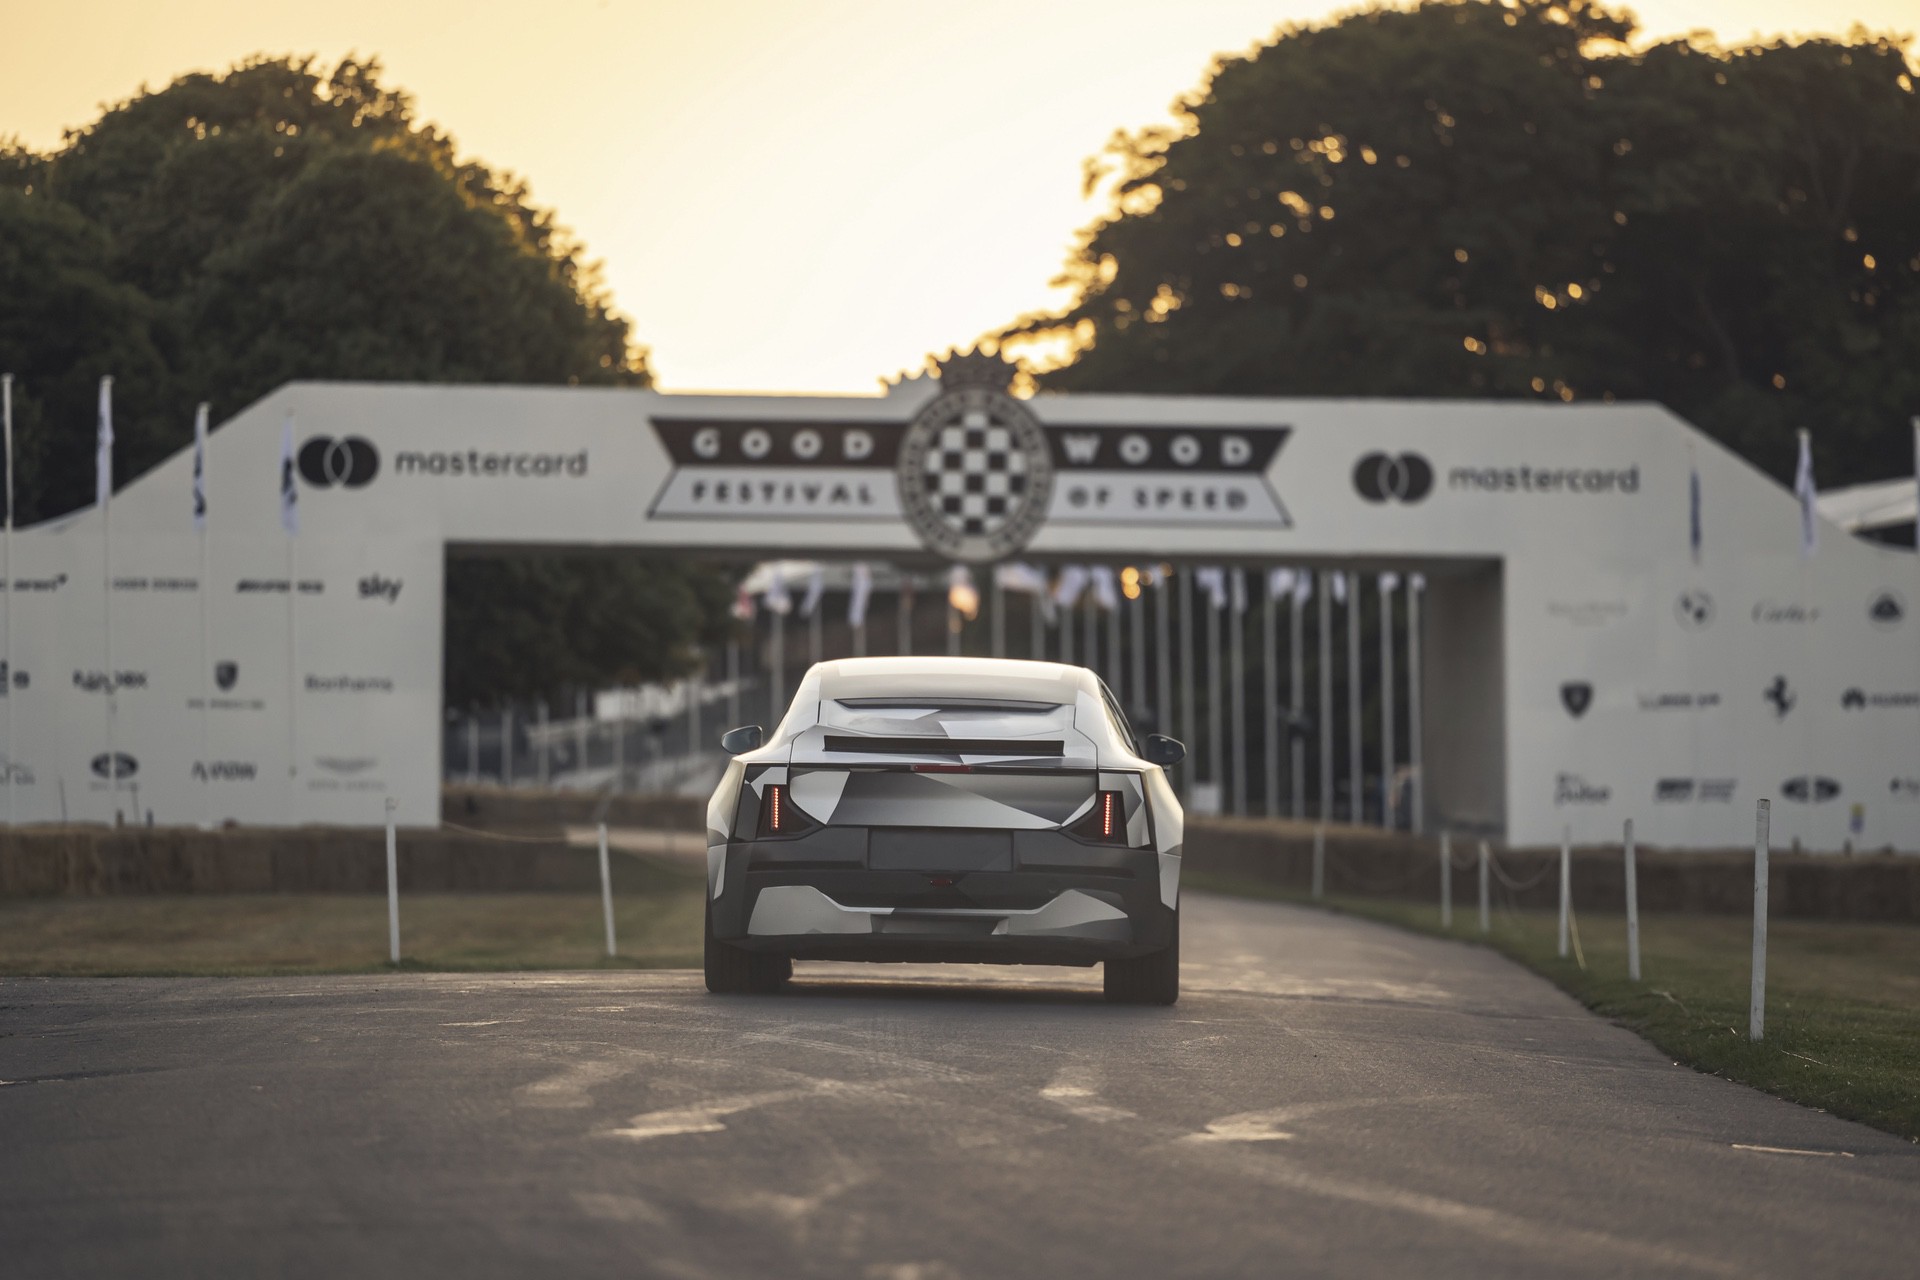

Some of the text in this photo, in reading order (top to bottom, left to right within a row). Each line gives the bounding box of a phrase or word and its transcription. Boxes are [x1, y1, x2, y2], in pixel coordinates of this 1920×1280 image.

[692, 428, 1253, 465] GOOD WOOD
[394, 449, 588, 477] mastercard
[1449, 466, 1639, 494] mastercard
[691, 480, 1249, 511] FESTIVAL OF SPEED
[358, 573, 402, 603] sky
